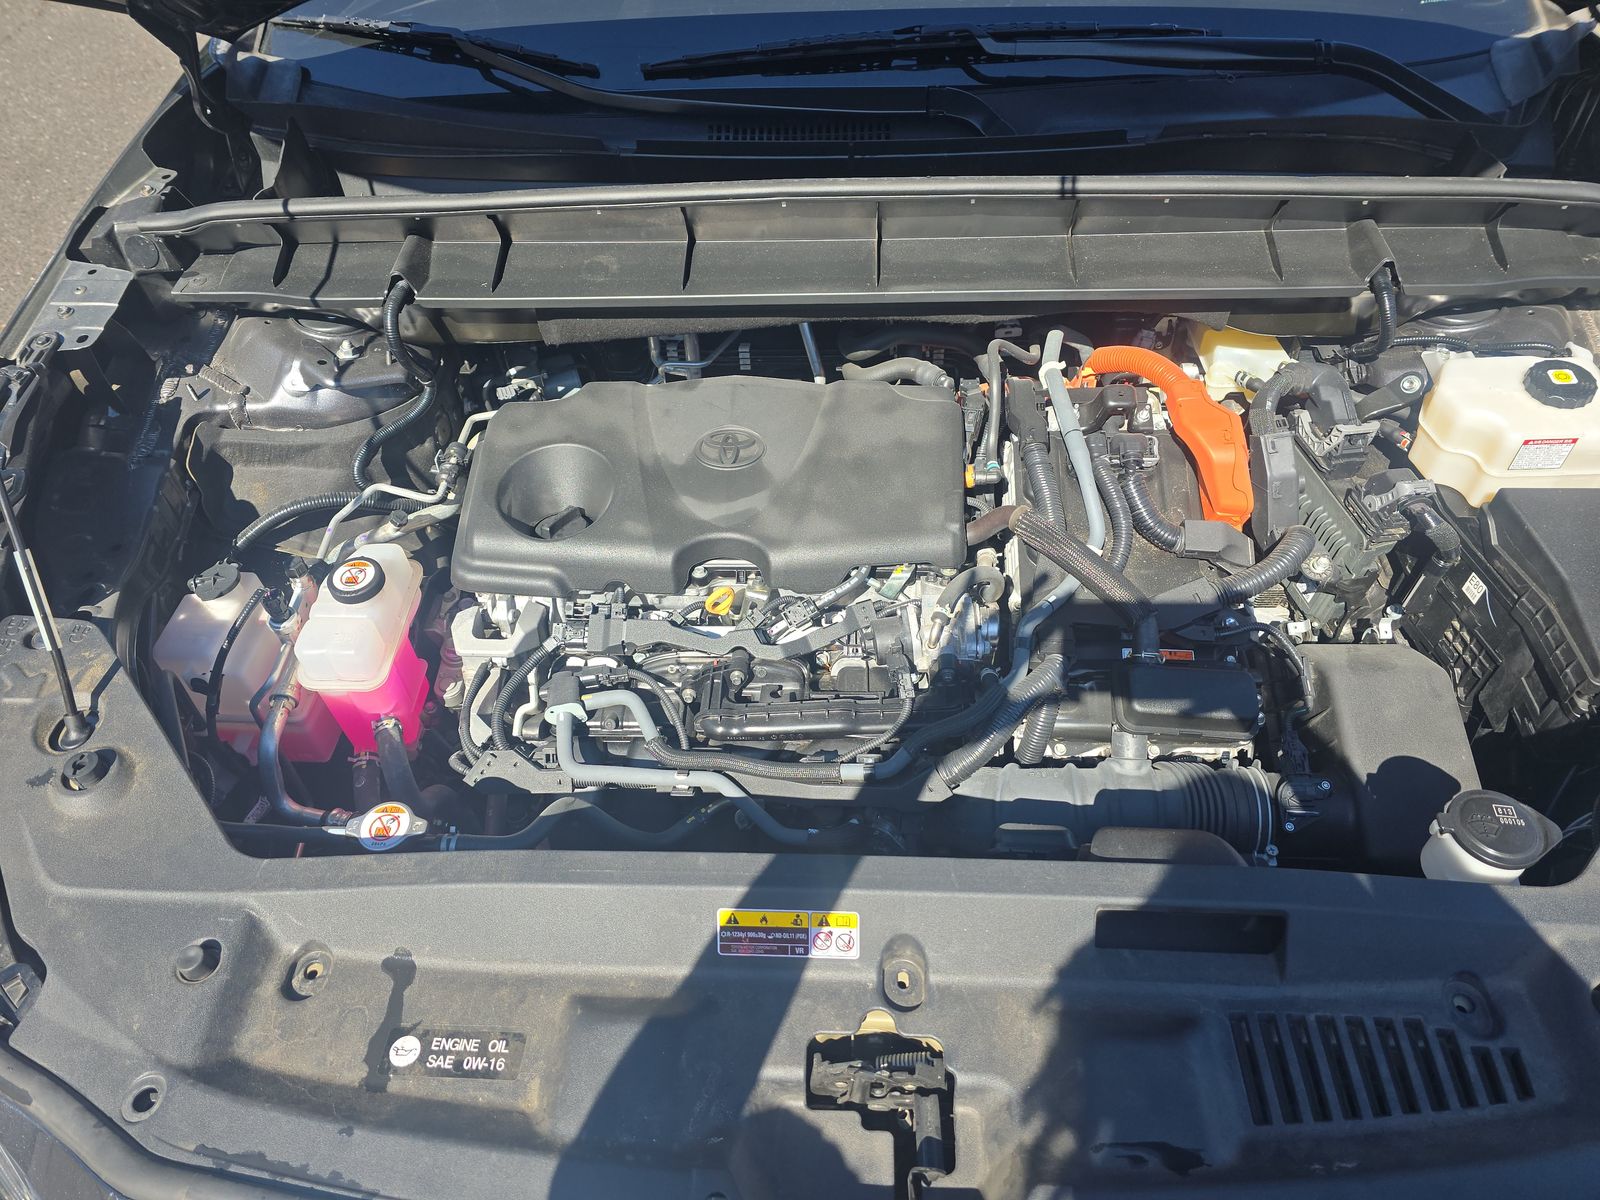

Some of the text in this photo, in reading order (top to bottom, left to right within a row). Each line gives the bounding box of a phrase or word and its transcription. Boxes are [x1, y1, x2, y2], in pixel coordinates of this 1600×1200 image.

[1468, 575, 1484, 594] E80
[431, 1037, 509, 1053] ENGINE OIL
[426, 1055, 506, 1071] SAE 0W-16
